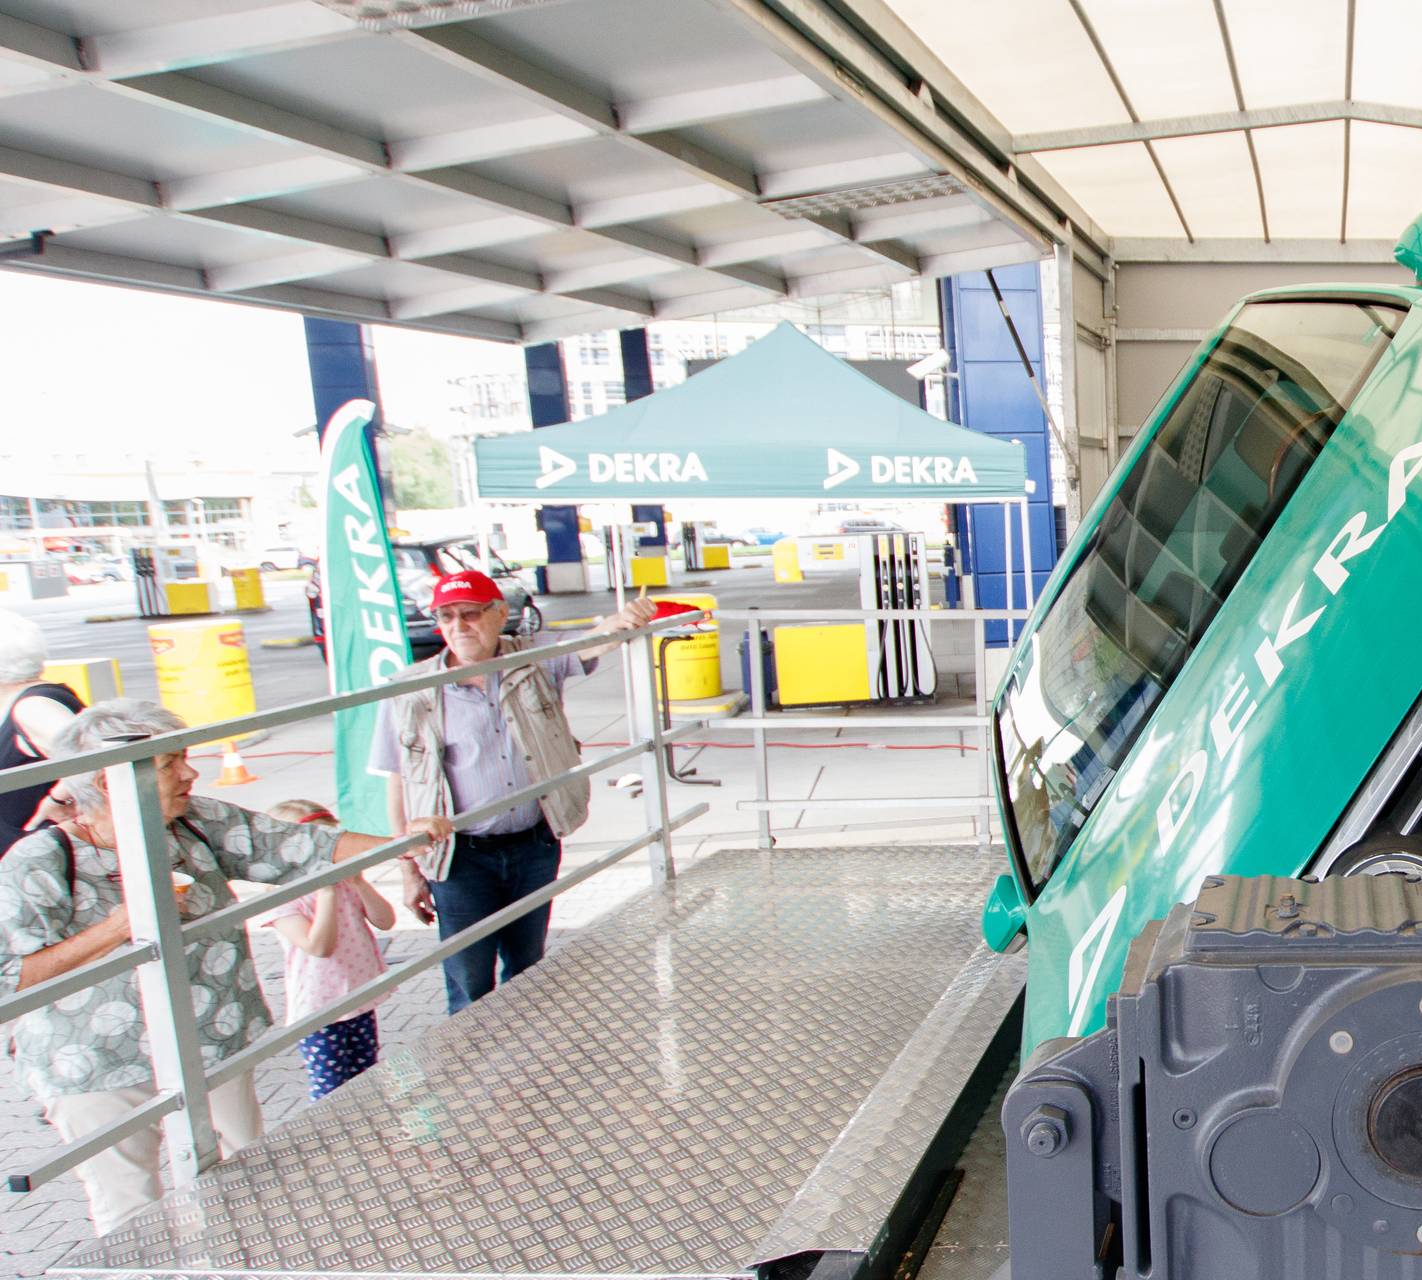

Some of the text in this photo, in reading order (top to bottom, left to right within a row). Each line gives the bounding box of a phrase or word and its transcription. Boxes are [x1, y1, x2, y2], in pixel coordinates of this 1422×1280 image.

[588, 452, 708, 483] DEKRA
[871, 455, 978, 484] DEKRA
[333, 463, 405, 687] DEKRA
